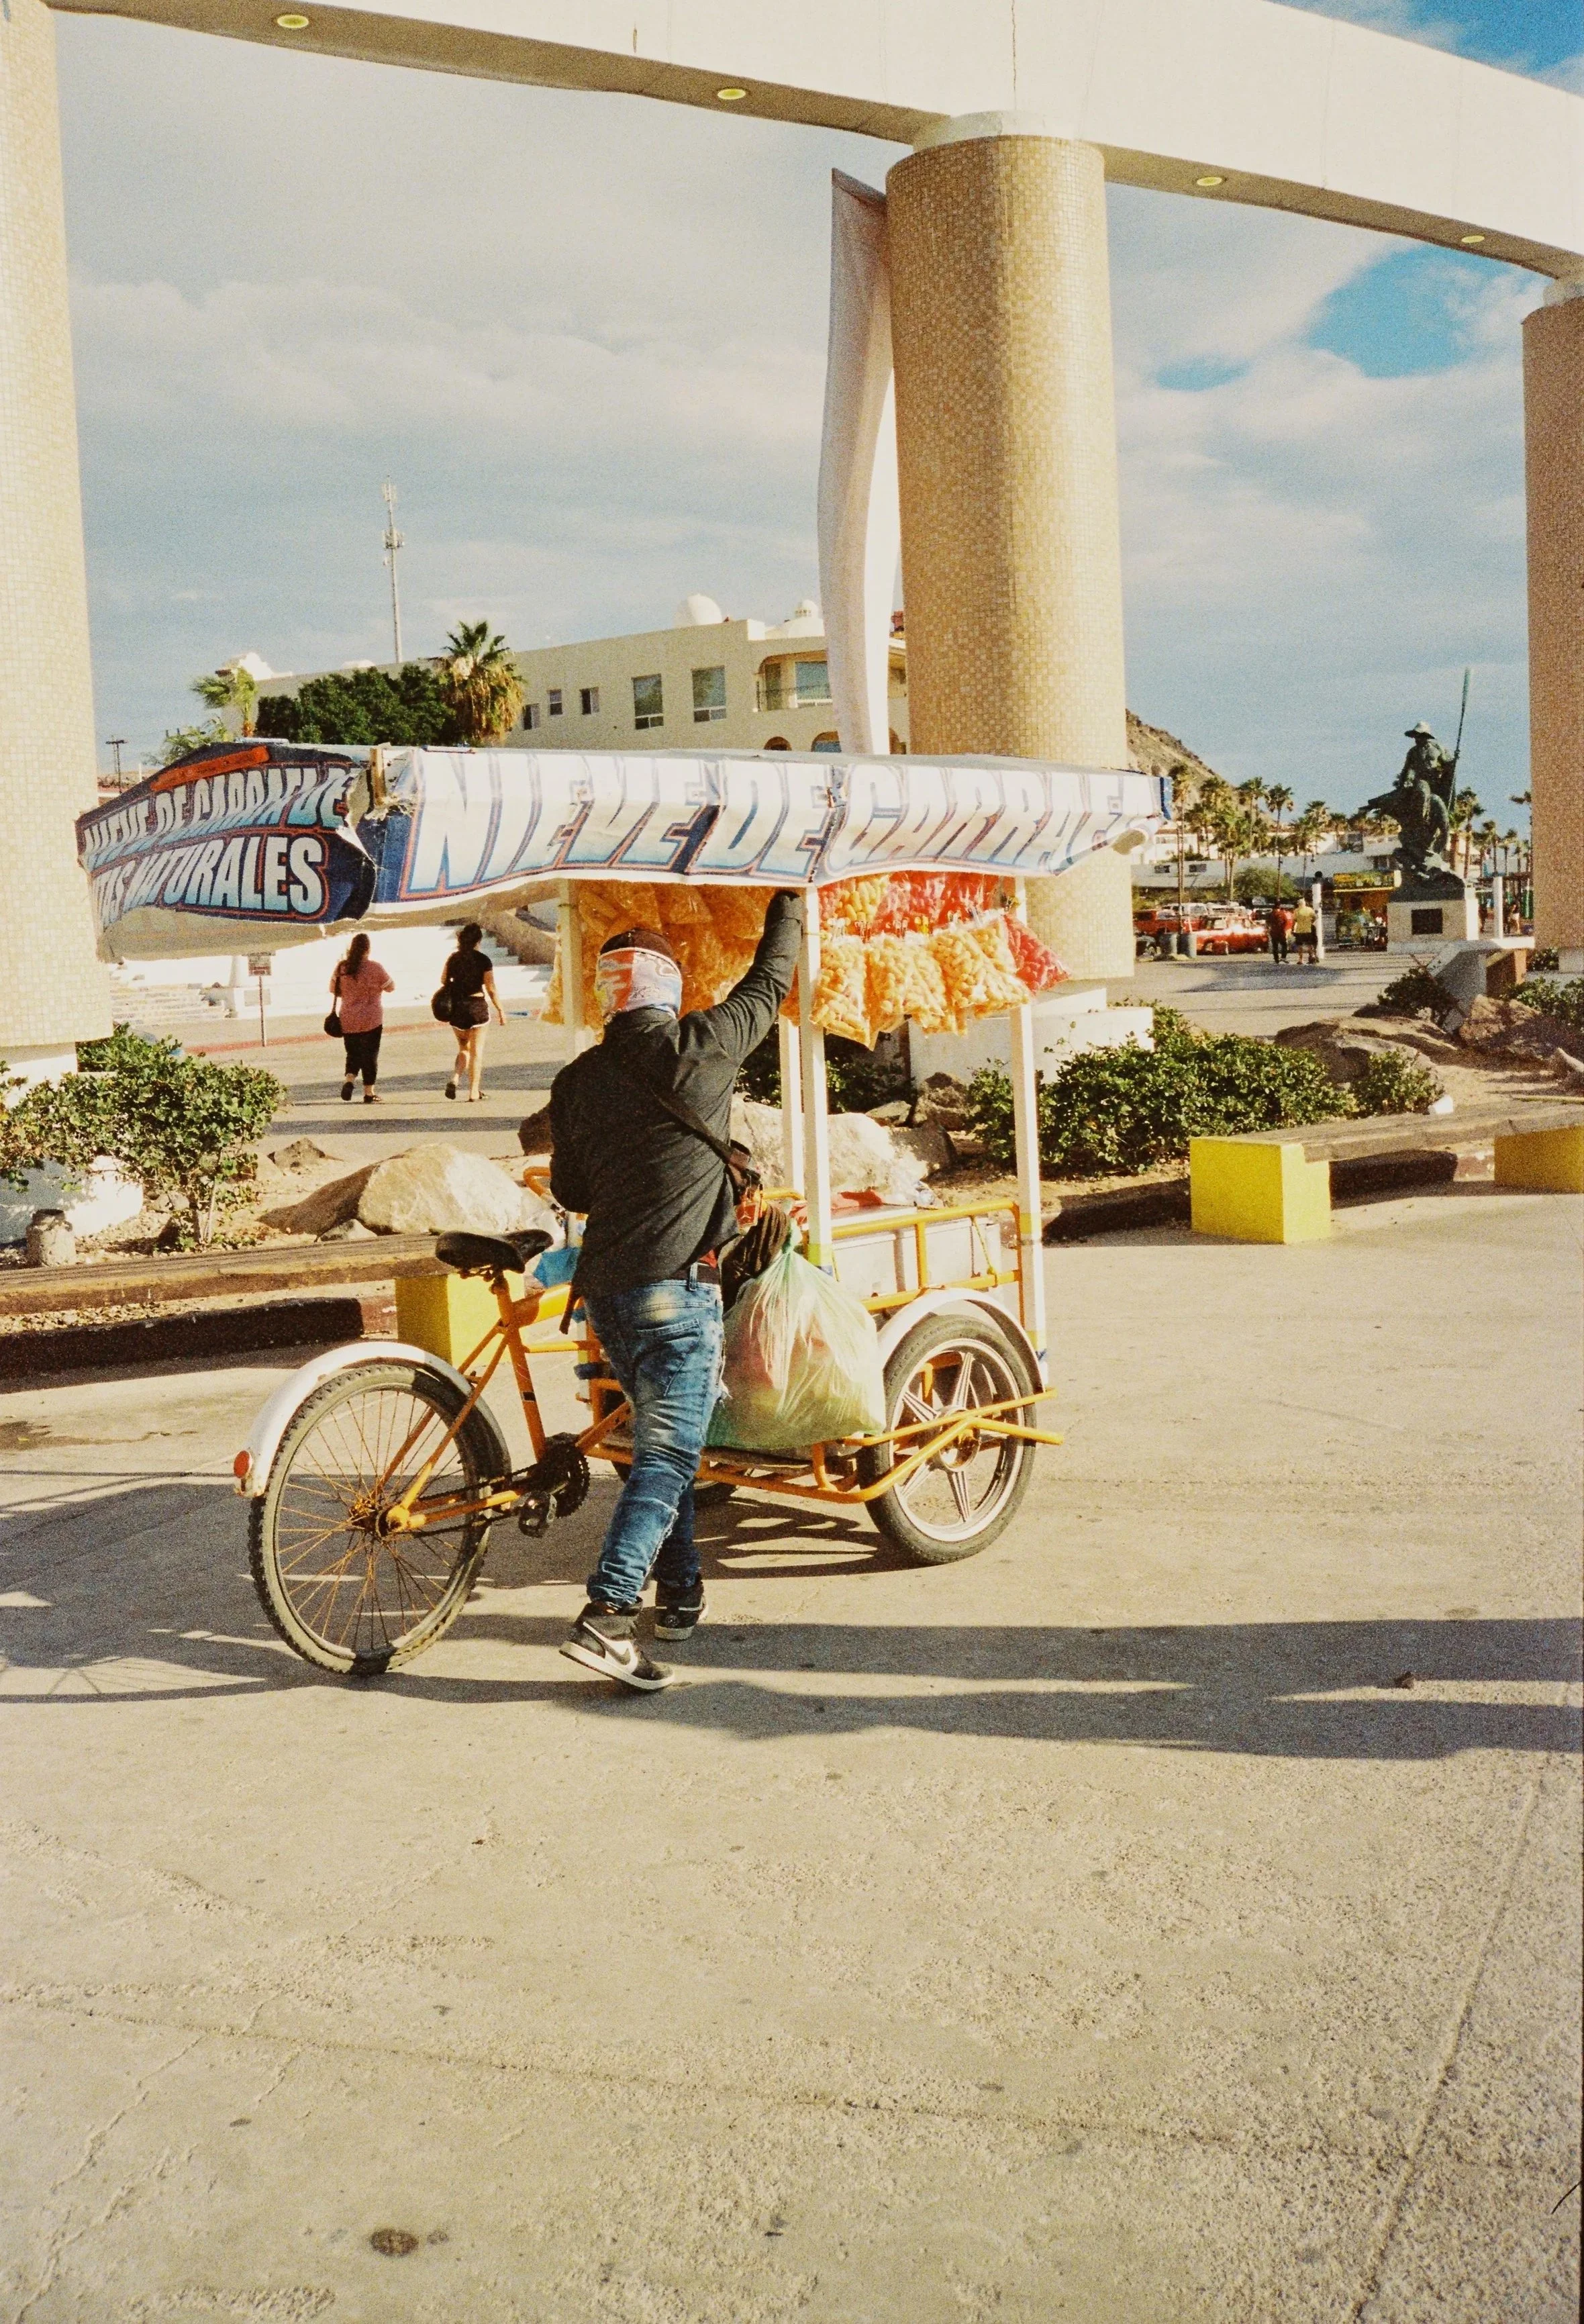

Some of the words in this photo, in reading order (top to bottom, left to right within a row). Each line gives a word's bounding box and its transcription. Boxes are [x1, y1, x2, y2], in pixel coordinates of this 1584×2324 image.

[123, 785, 186, 856] DE
[287, 767, 361, 828] DE
[403, 751, 704, 895] NIEVE
[693, 759, 830, 878] DE
[123, 836, 323, 915] NATURALES
